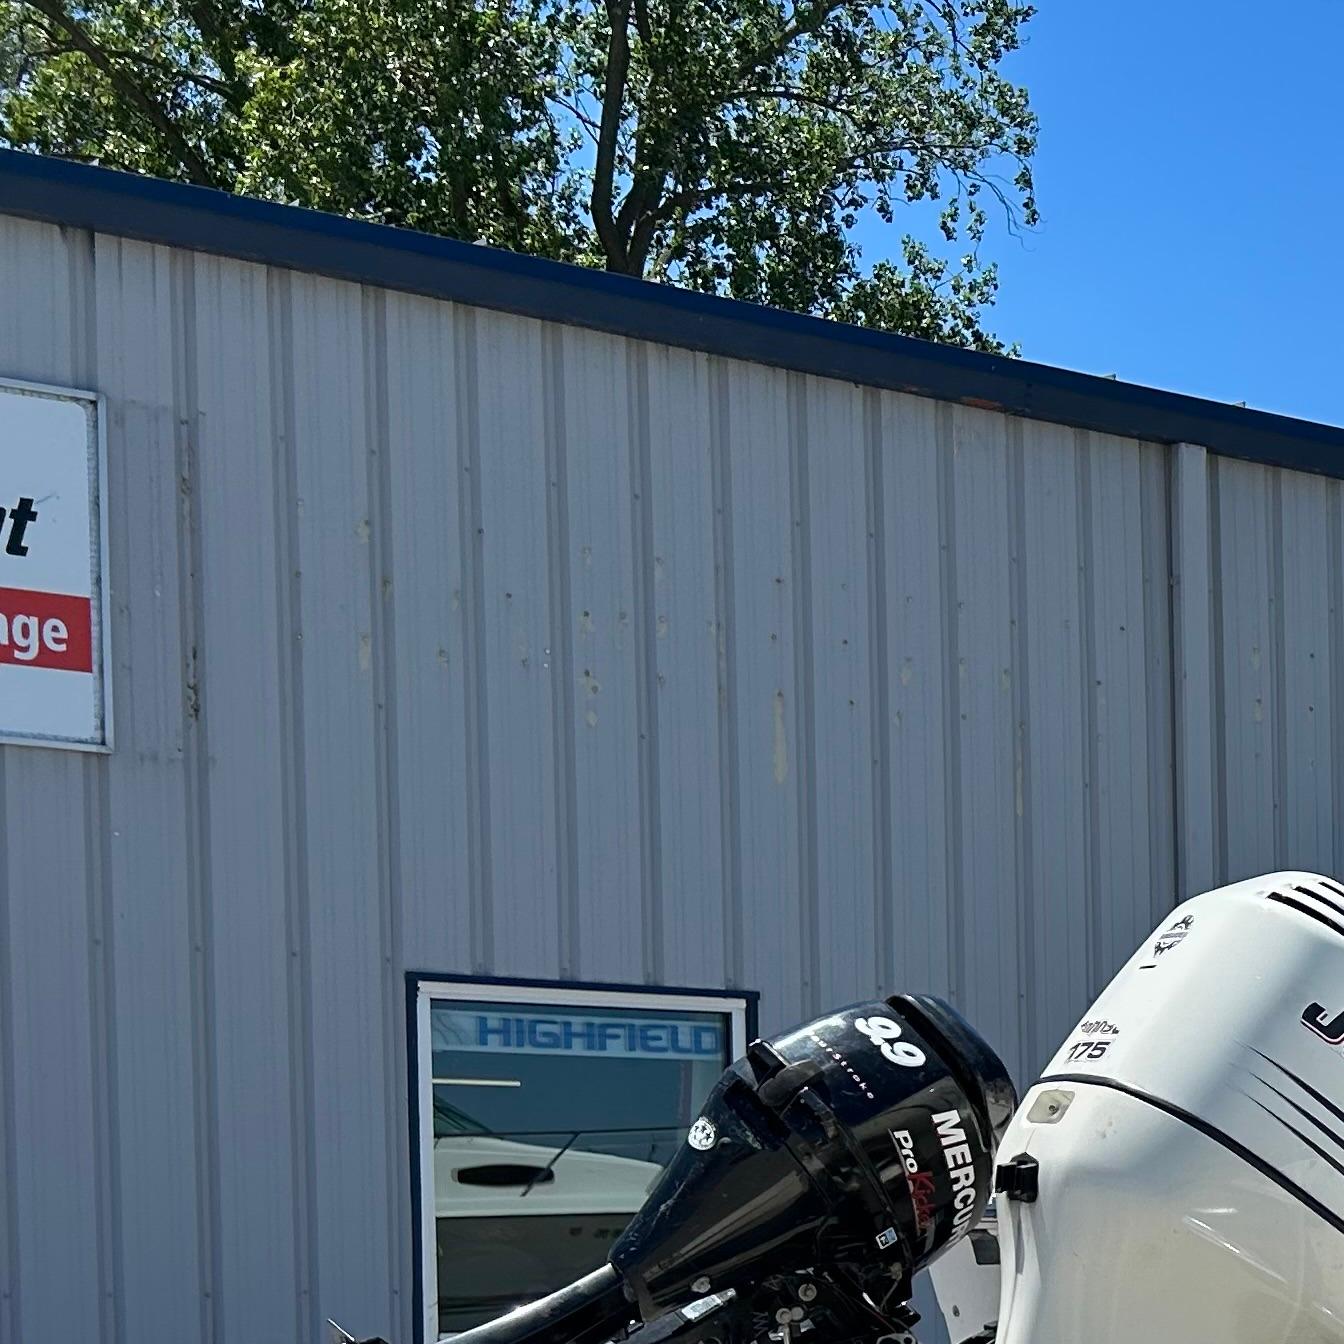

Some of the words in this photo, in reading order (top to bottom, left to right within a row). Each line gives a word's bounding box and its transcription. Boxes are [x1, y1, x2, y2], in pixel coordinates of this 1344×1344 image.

[0, 497, 38, 557] t
[477, 1014, 720, 1055] HIGHFIELD
[854, 1016, 927, 1067] 9.9
[1068, 1041, 1112, 1060] 175
[931, 1109, 977, 1240] MERCUR
